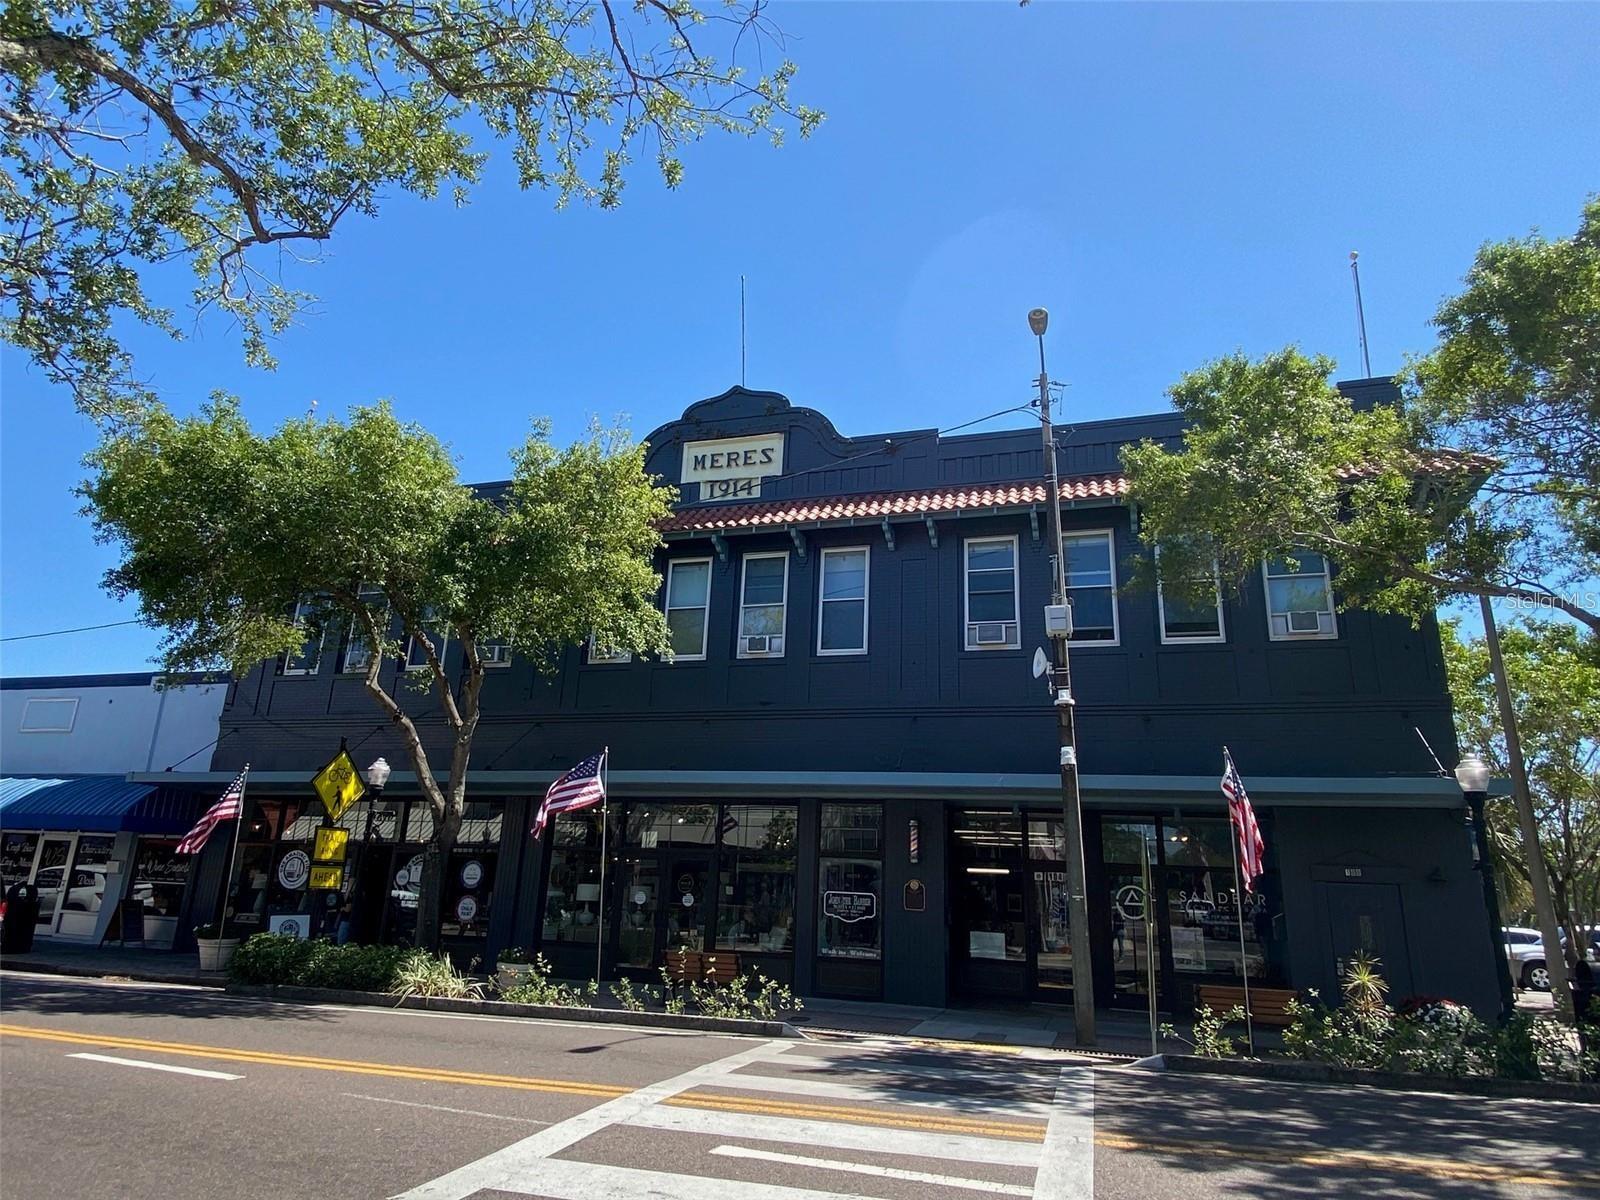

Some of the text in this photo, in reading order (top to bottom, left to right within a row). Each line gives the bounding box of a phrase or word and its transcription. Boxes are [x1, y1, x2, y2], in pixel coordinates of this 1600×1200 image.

[693, 447, 774, 471] MERES
[708, 479, 753, 498] 1914
[313, 871, 338, 882] AHEAD
